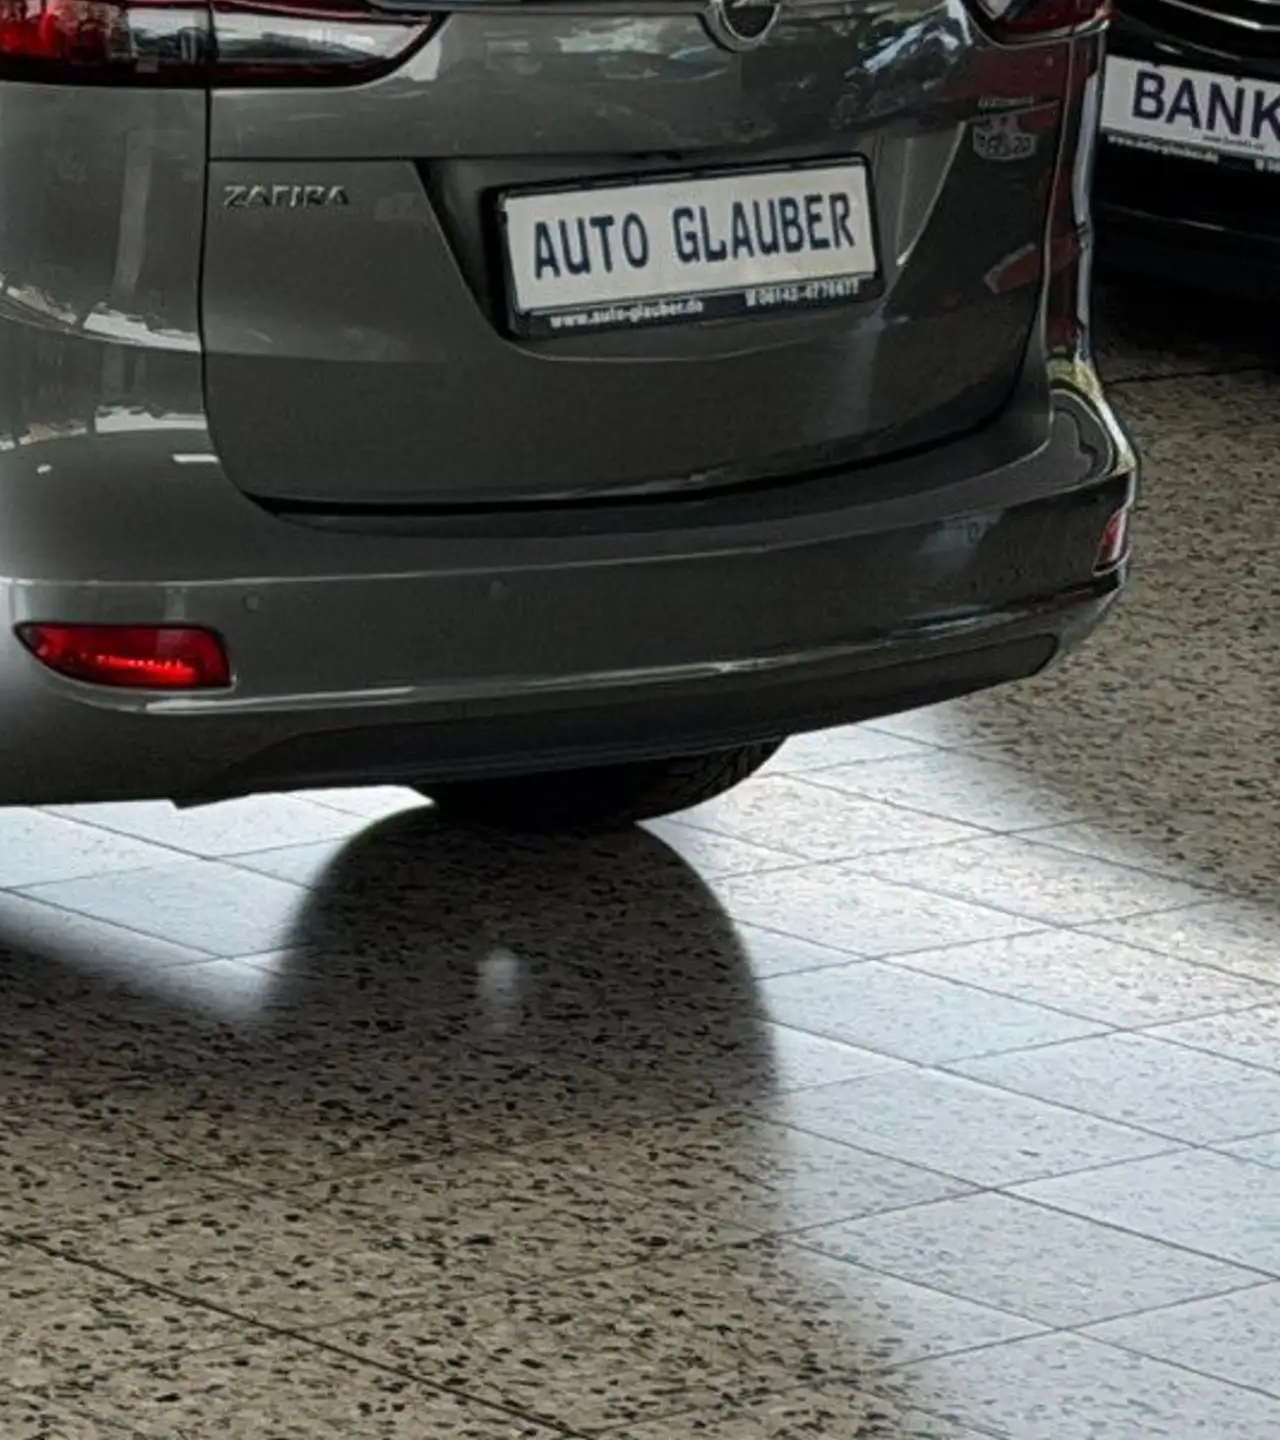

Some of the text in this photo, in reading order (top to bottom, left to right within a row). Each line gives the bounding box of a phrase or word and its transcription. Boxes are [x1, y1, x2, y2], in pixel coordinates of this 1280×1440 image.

[1132, 69, 1280, 141] BANK
[223, 185, 349, 208] ZAFIRA
[534, 192, 855, 280] AUTO GLAUBER
